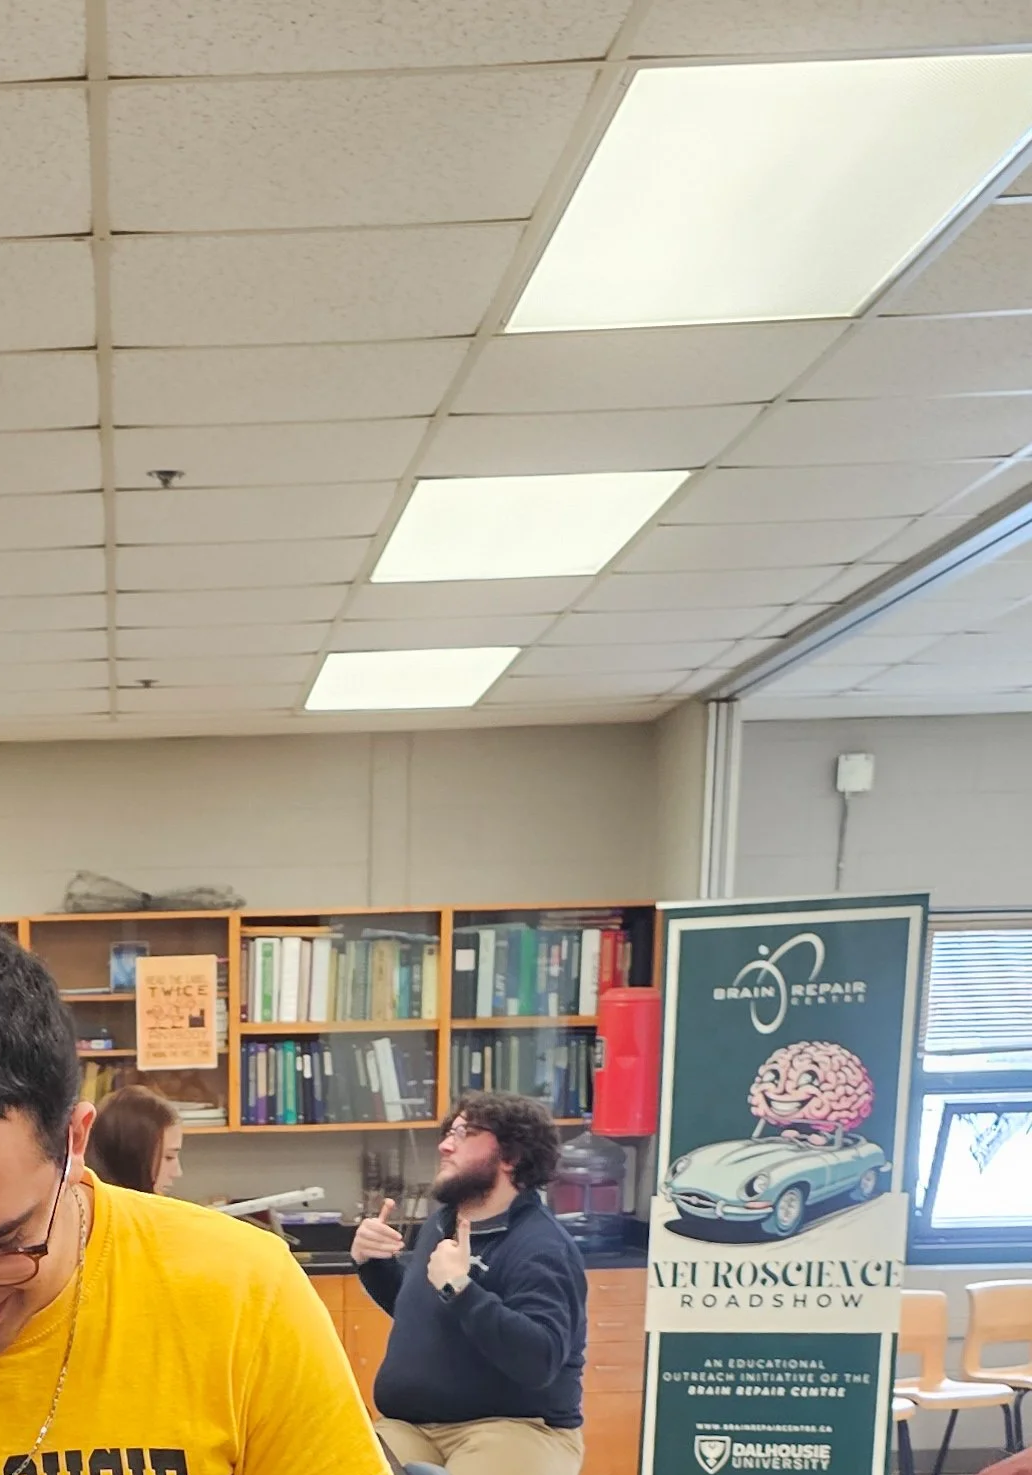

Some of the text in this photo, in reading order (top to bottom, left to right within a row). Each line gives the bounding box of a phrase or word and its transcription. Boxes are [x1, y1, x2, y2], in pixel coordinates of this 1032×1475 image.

[148, 985, 208, 998] TWICE
[713, 981, 867, 1000] BRAIN REPAIR
[649, 1260, 903, 1288] NEUROSCIENCE
[680, 1294, 863, 1308] ROADSHOW
[704, 1358, 826, 1369] AN EDUCATIONAL
[662, 1372, 871, 1384] OUTREACH INITIATIVE OF THE
[688, 1385, 846, 1398] BRAIN REPAIR CENTRE
[732, 1442, 831, 1458] DALHOUSIE
[732, 1457, 831, 1470] UNIVERSITY
